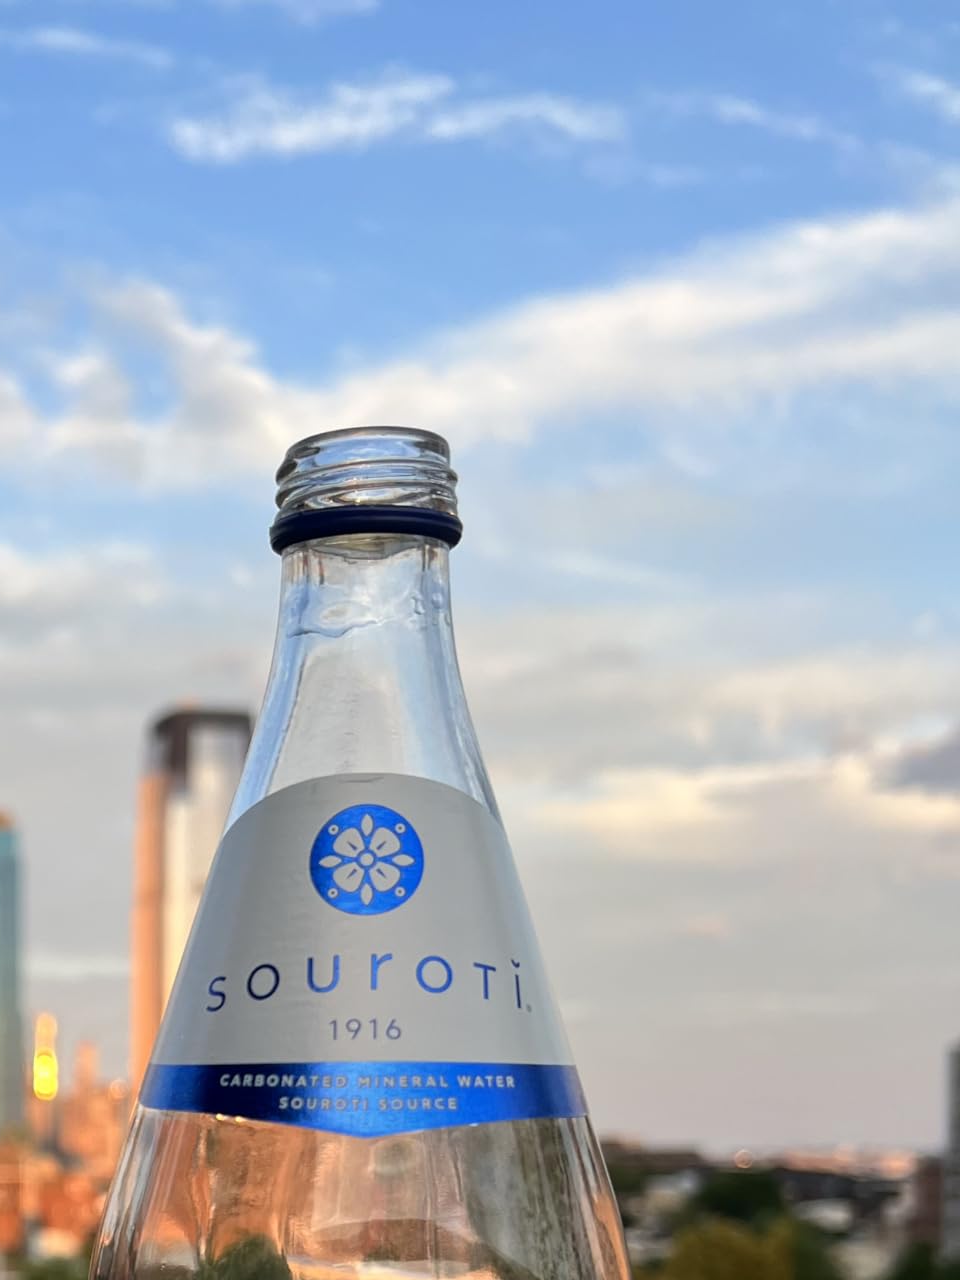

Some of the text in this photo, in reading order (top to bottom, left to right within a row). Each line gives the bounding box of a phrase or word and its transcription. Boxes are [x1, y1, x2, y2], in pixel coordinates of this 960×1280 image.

[329, 1018, 402, 1041] 1916
[219, 1073, 516, 1089] CARBONATED MINERAL WATER
[278, 1096, 458, 1111] SOUROTI SOURCE
